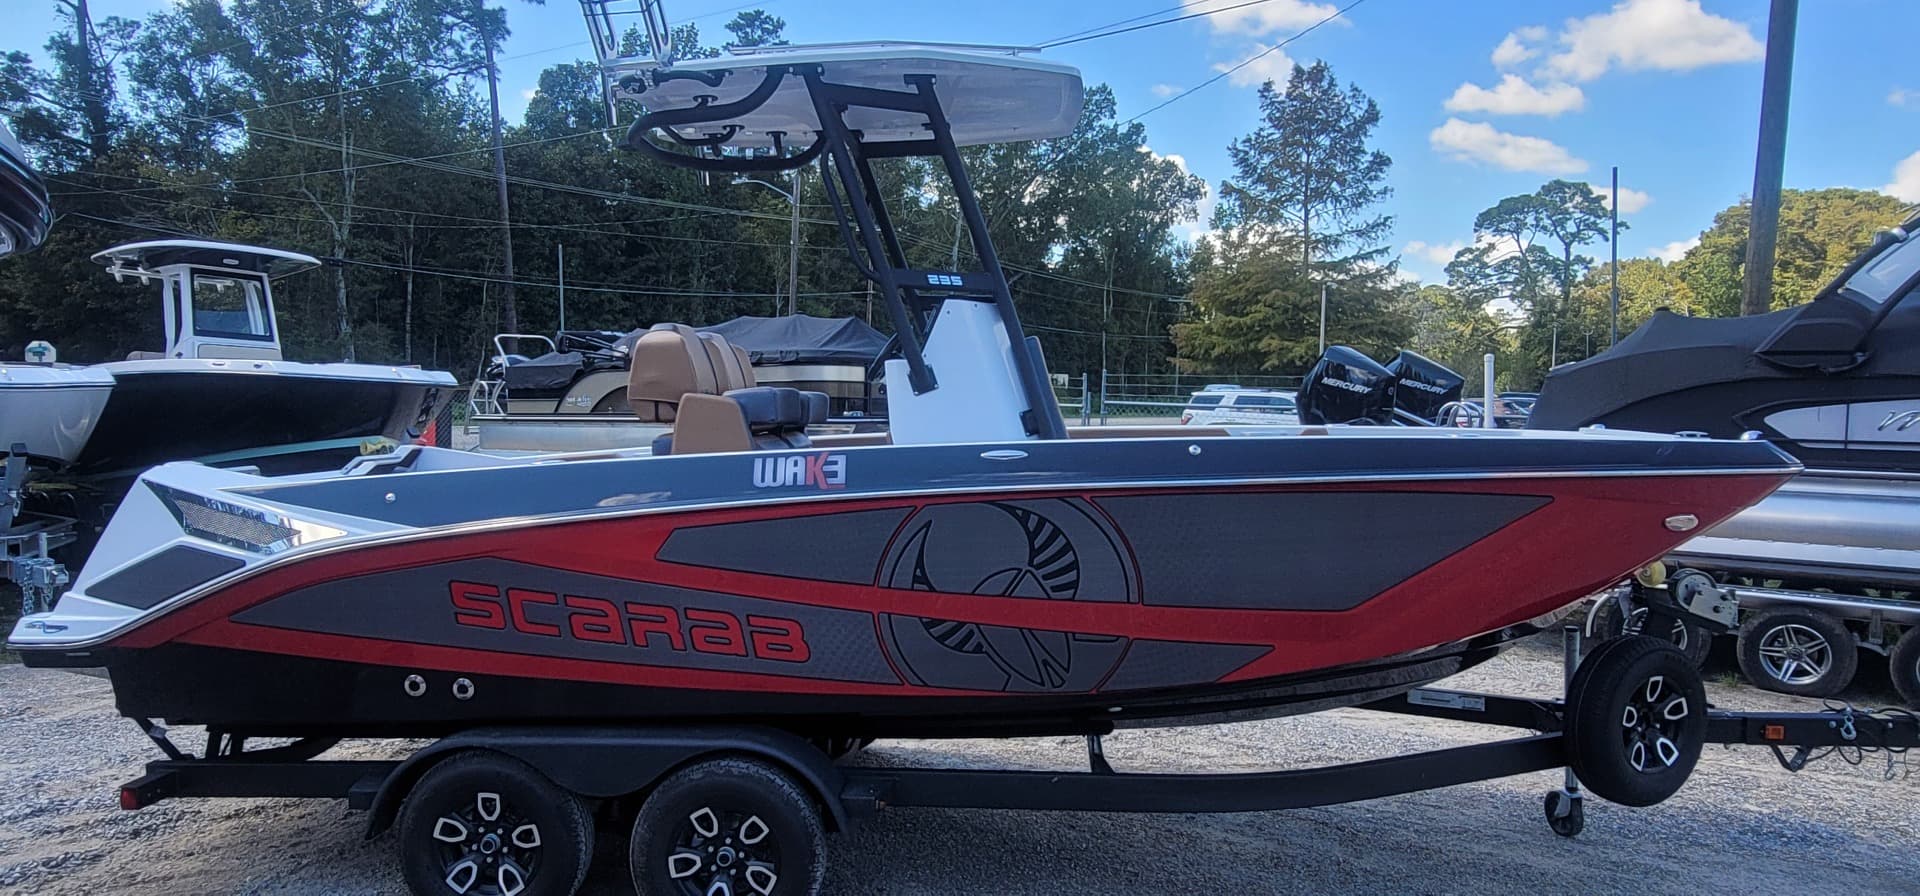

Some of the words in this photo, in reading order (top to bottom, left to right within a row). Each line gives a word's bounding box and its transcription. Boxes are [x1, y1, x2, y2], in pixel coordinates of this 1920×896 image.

[927, 274, 963, 286] 235
[1321, 376, 1372, 394] MERCURY
[1400, 377, 1448, 395] MERCURY
